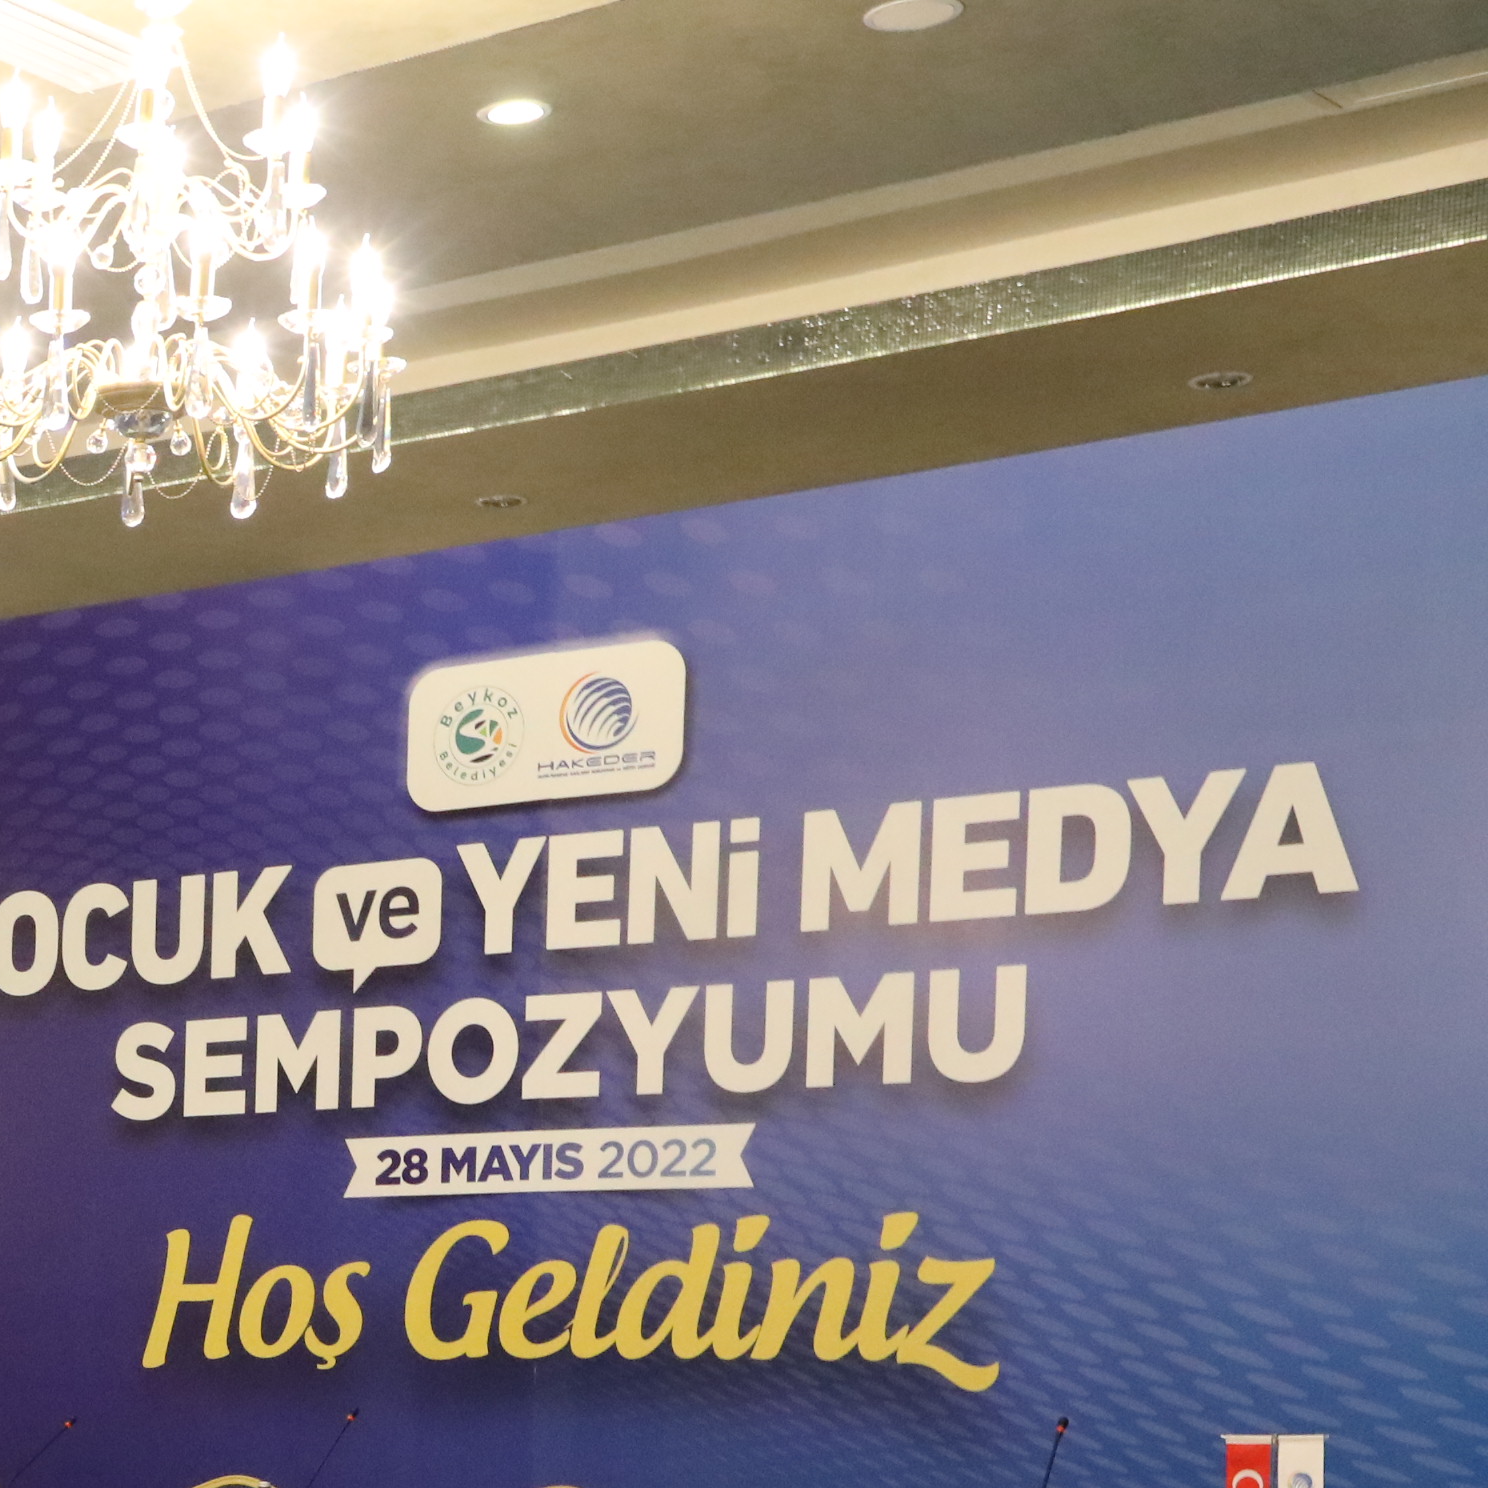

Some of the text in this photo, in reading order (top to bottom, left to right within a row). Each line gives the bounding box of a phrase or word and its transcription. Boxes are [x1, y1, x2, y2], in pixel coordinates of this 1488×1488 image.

[537, 751, 657, 772] HAKEDER
[336, 886, 420, 942] ve
[801, 761, 1359, 932] MEDYA
[111, 964, 1027, 1121] SEMPOZYUMU
[375, 1138, 717, 1186] 28 MAYIS 2022
[142, 1211, 1000, 1392] Hoş Geldiniz
